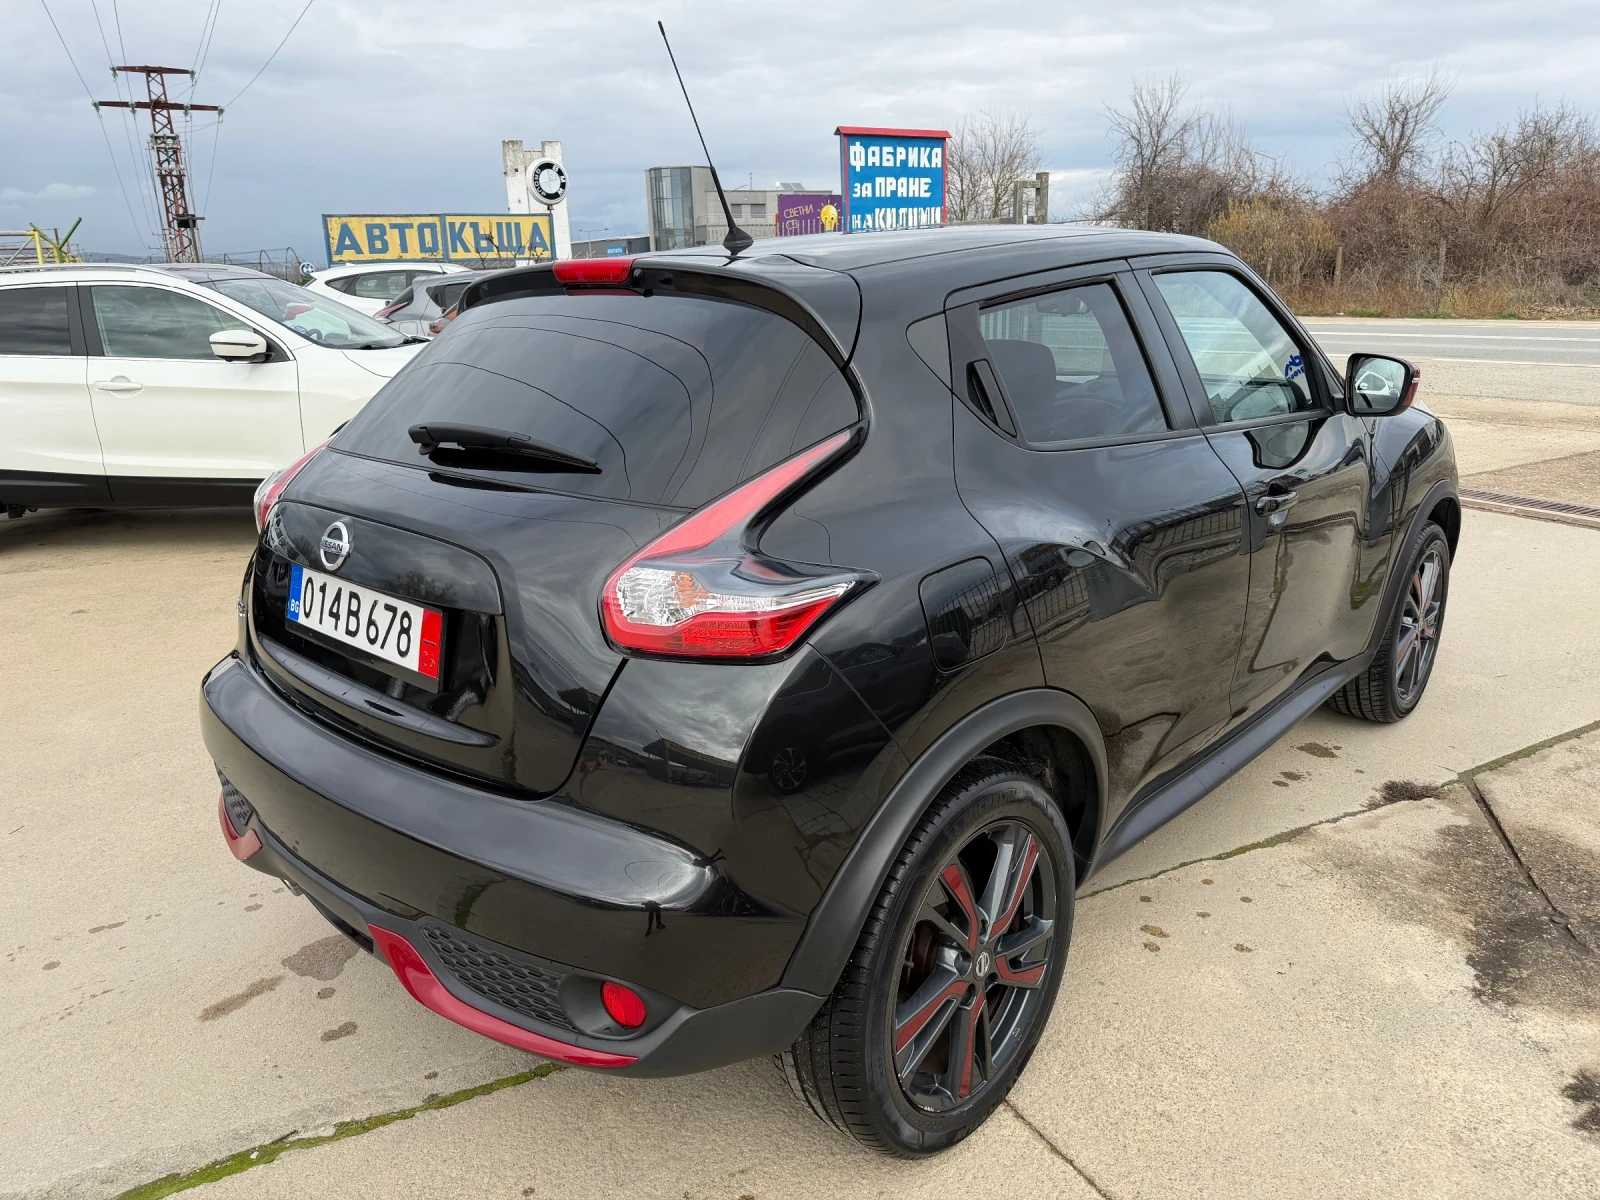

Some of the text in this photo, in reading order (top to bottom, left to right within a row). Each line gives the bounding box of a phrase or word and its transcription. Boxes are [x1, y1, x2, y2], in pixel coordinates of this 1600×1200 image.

[849, 142, 942, 172] ФАБРИКА
[875, 177, 932, 198] ПРАНЕ
[783, 204, 814, 219] СВЕТНИ
[874, 207, 941, 229] КИЛИМИ
[334, 221, 549, 256] АВТО КЪЩА
[290, 598, 299, 614] BG
[303, 577, 413, 658] 014B678
